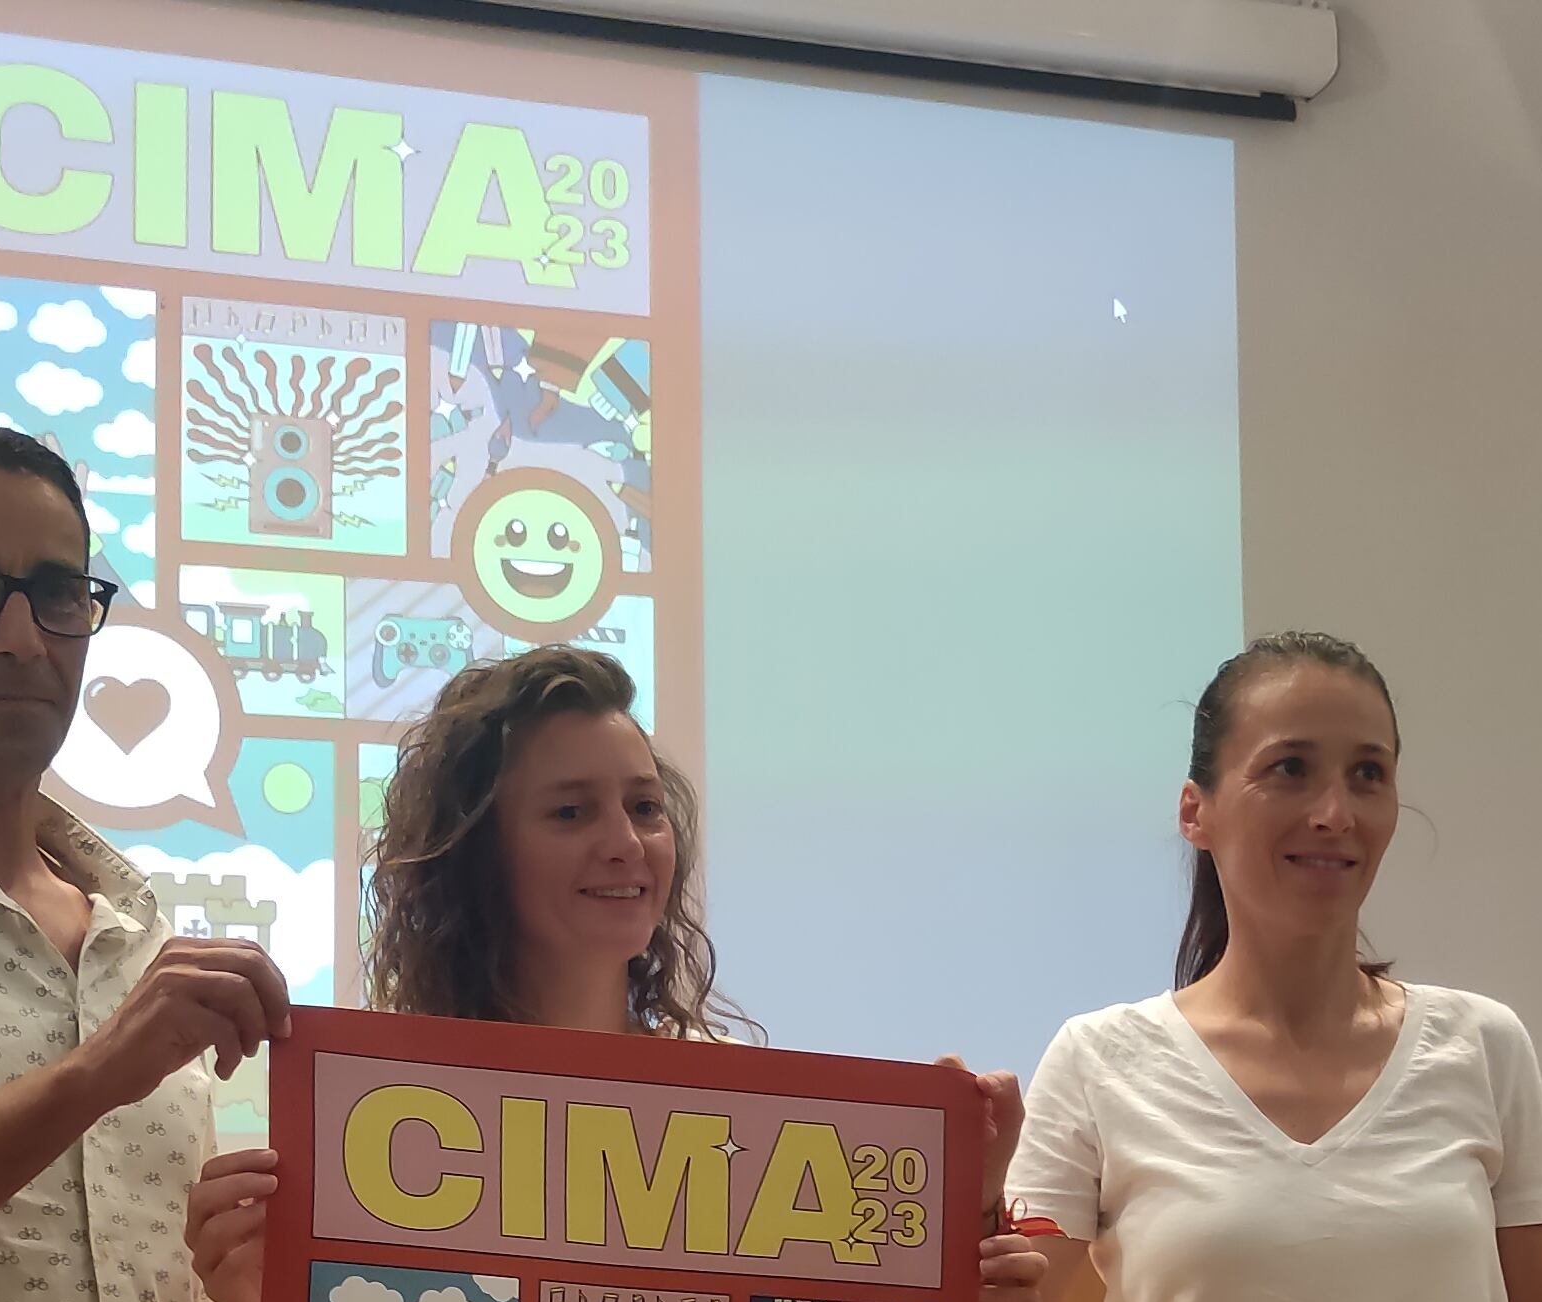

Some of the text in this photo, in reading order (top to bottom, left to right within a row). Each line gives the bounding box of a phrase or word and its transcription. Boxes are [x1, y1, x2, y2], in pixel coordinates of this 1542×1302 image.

[543, 153, 630, 210] 20
[543, 213, 631, 270] 23
[342, 1084, 881, 1266] CIMA
[852, 1145, 928, 1195] 20
[852, 1199, 928, 1248] 23
